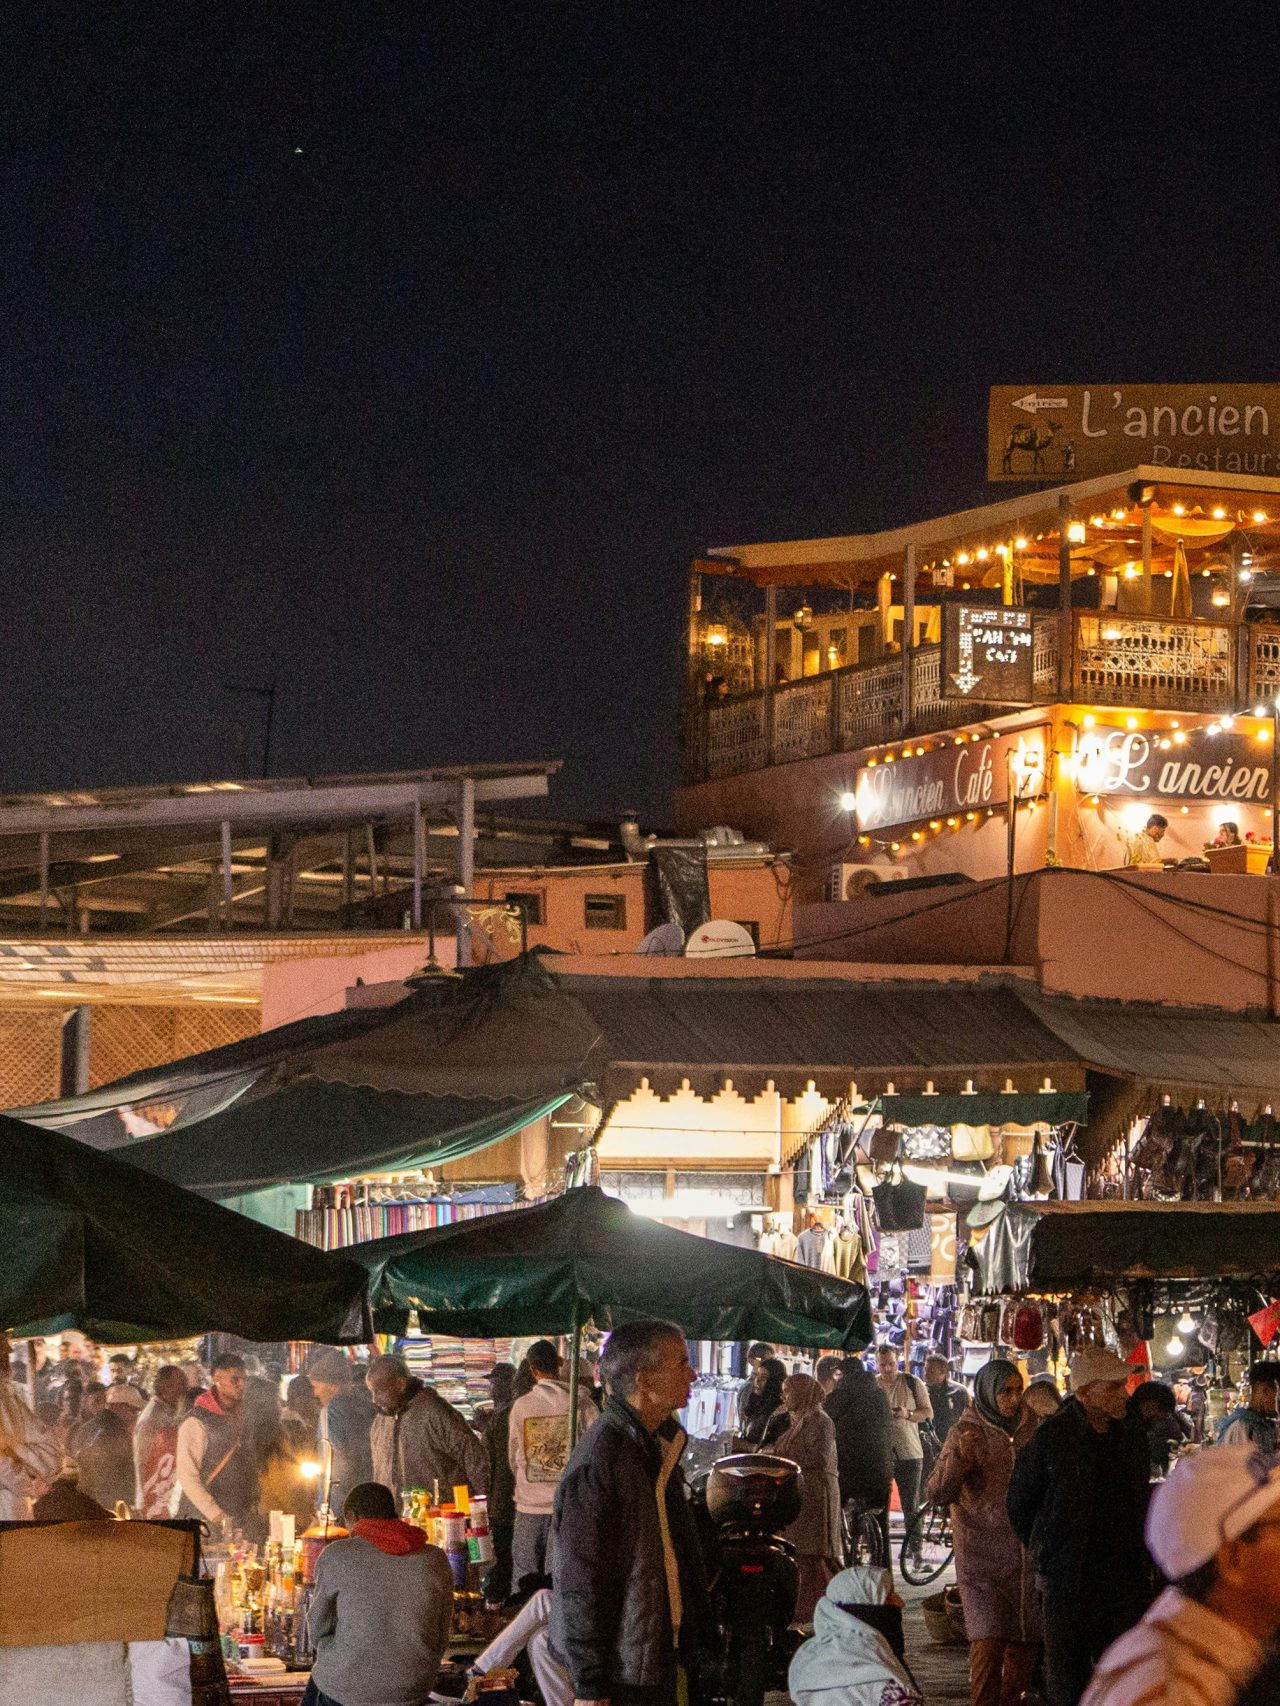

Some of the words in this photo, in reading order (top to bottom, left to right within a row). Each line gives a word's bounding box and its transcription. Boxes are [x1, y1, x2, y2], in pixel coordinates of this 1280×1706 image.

[1082, 390, 1269, 438] L'ancien
[955, 745, 993, 806] Café
[1102, 731, 1269, 799] L'ancien
